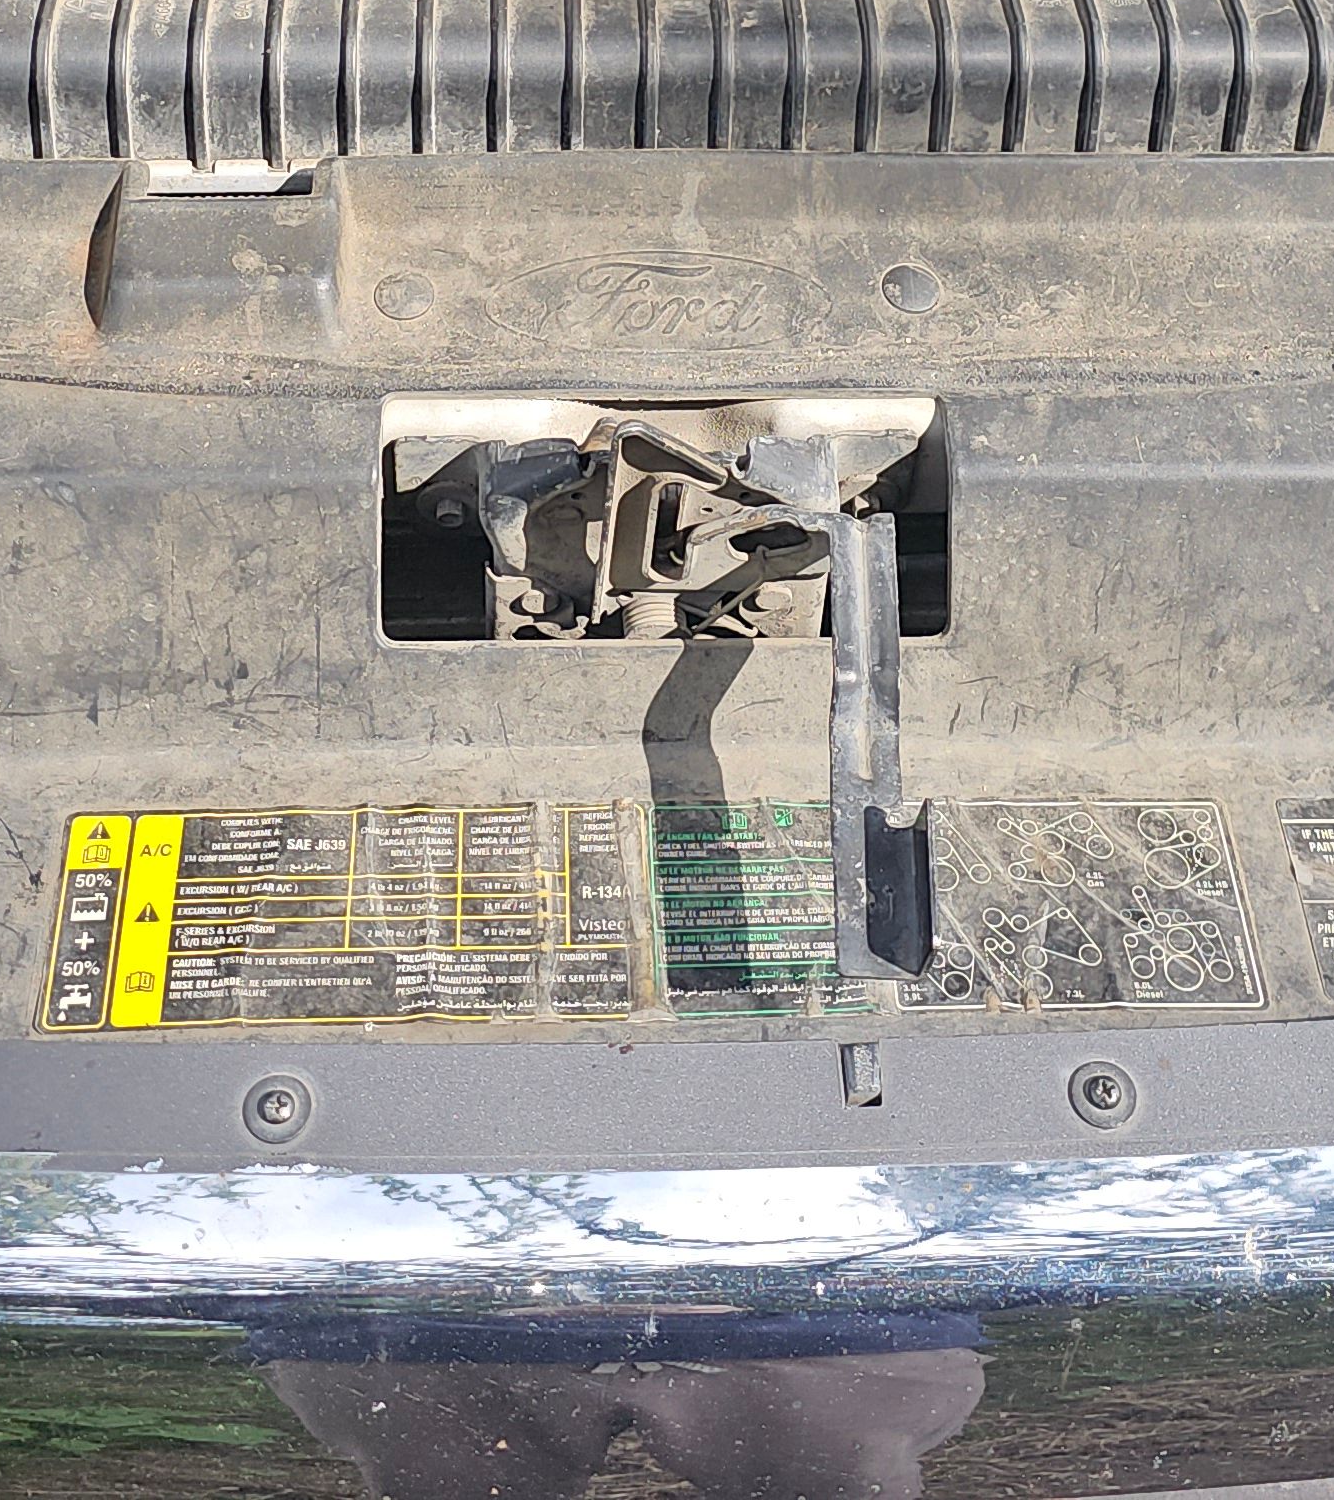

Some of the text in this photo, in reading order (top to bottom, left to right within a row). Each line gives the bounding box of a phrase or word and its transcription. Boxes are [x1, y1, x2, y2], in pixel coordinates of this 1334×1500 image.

[574, 262, 767, 336] Ford
[1301, 829, 1312, 840] IF
[139, 843, 173, 857] A/C
[286, 838, 347, 851] SAE J639
[237, 865, 254, 874] SAE
[74, 873, 113, 888] 50%
[1086, 879, 1105, 888] Gas
[179, 882, 293, 896] EXCURSION REAR A/C
[1197, 888, 1225, 897] Diesel
[176, 905, 227, 916] EXCURSION
[226, 924, 276, 935] EXCURSION
[579, 917, 625, 932] Visteo
[201, 936, 244, 946] REAR A/C
[172, 955, 375, 968] CAUTION: SYSTEM TO BE SERVICED BY QUALIFIED
[460, 954, 471, 963] EL
[472, 953, 509, 963] SISTEMA
[509, 953, 531, 962] DEBE
[590, 952, 608, 961] POR
[61, 960, 101, 976] 50%
[169, 980, 195, 990] MISE
[196, 979, 209, 989] EN
[210, 977, 245, 988] GARDE:
[395, 973, 627, 985] AVISO: DO SER FEITA POR
[1135, 989, 1165, 1000] Diesel
